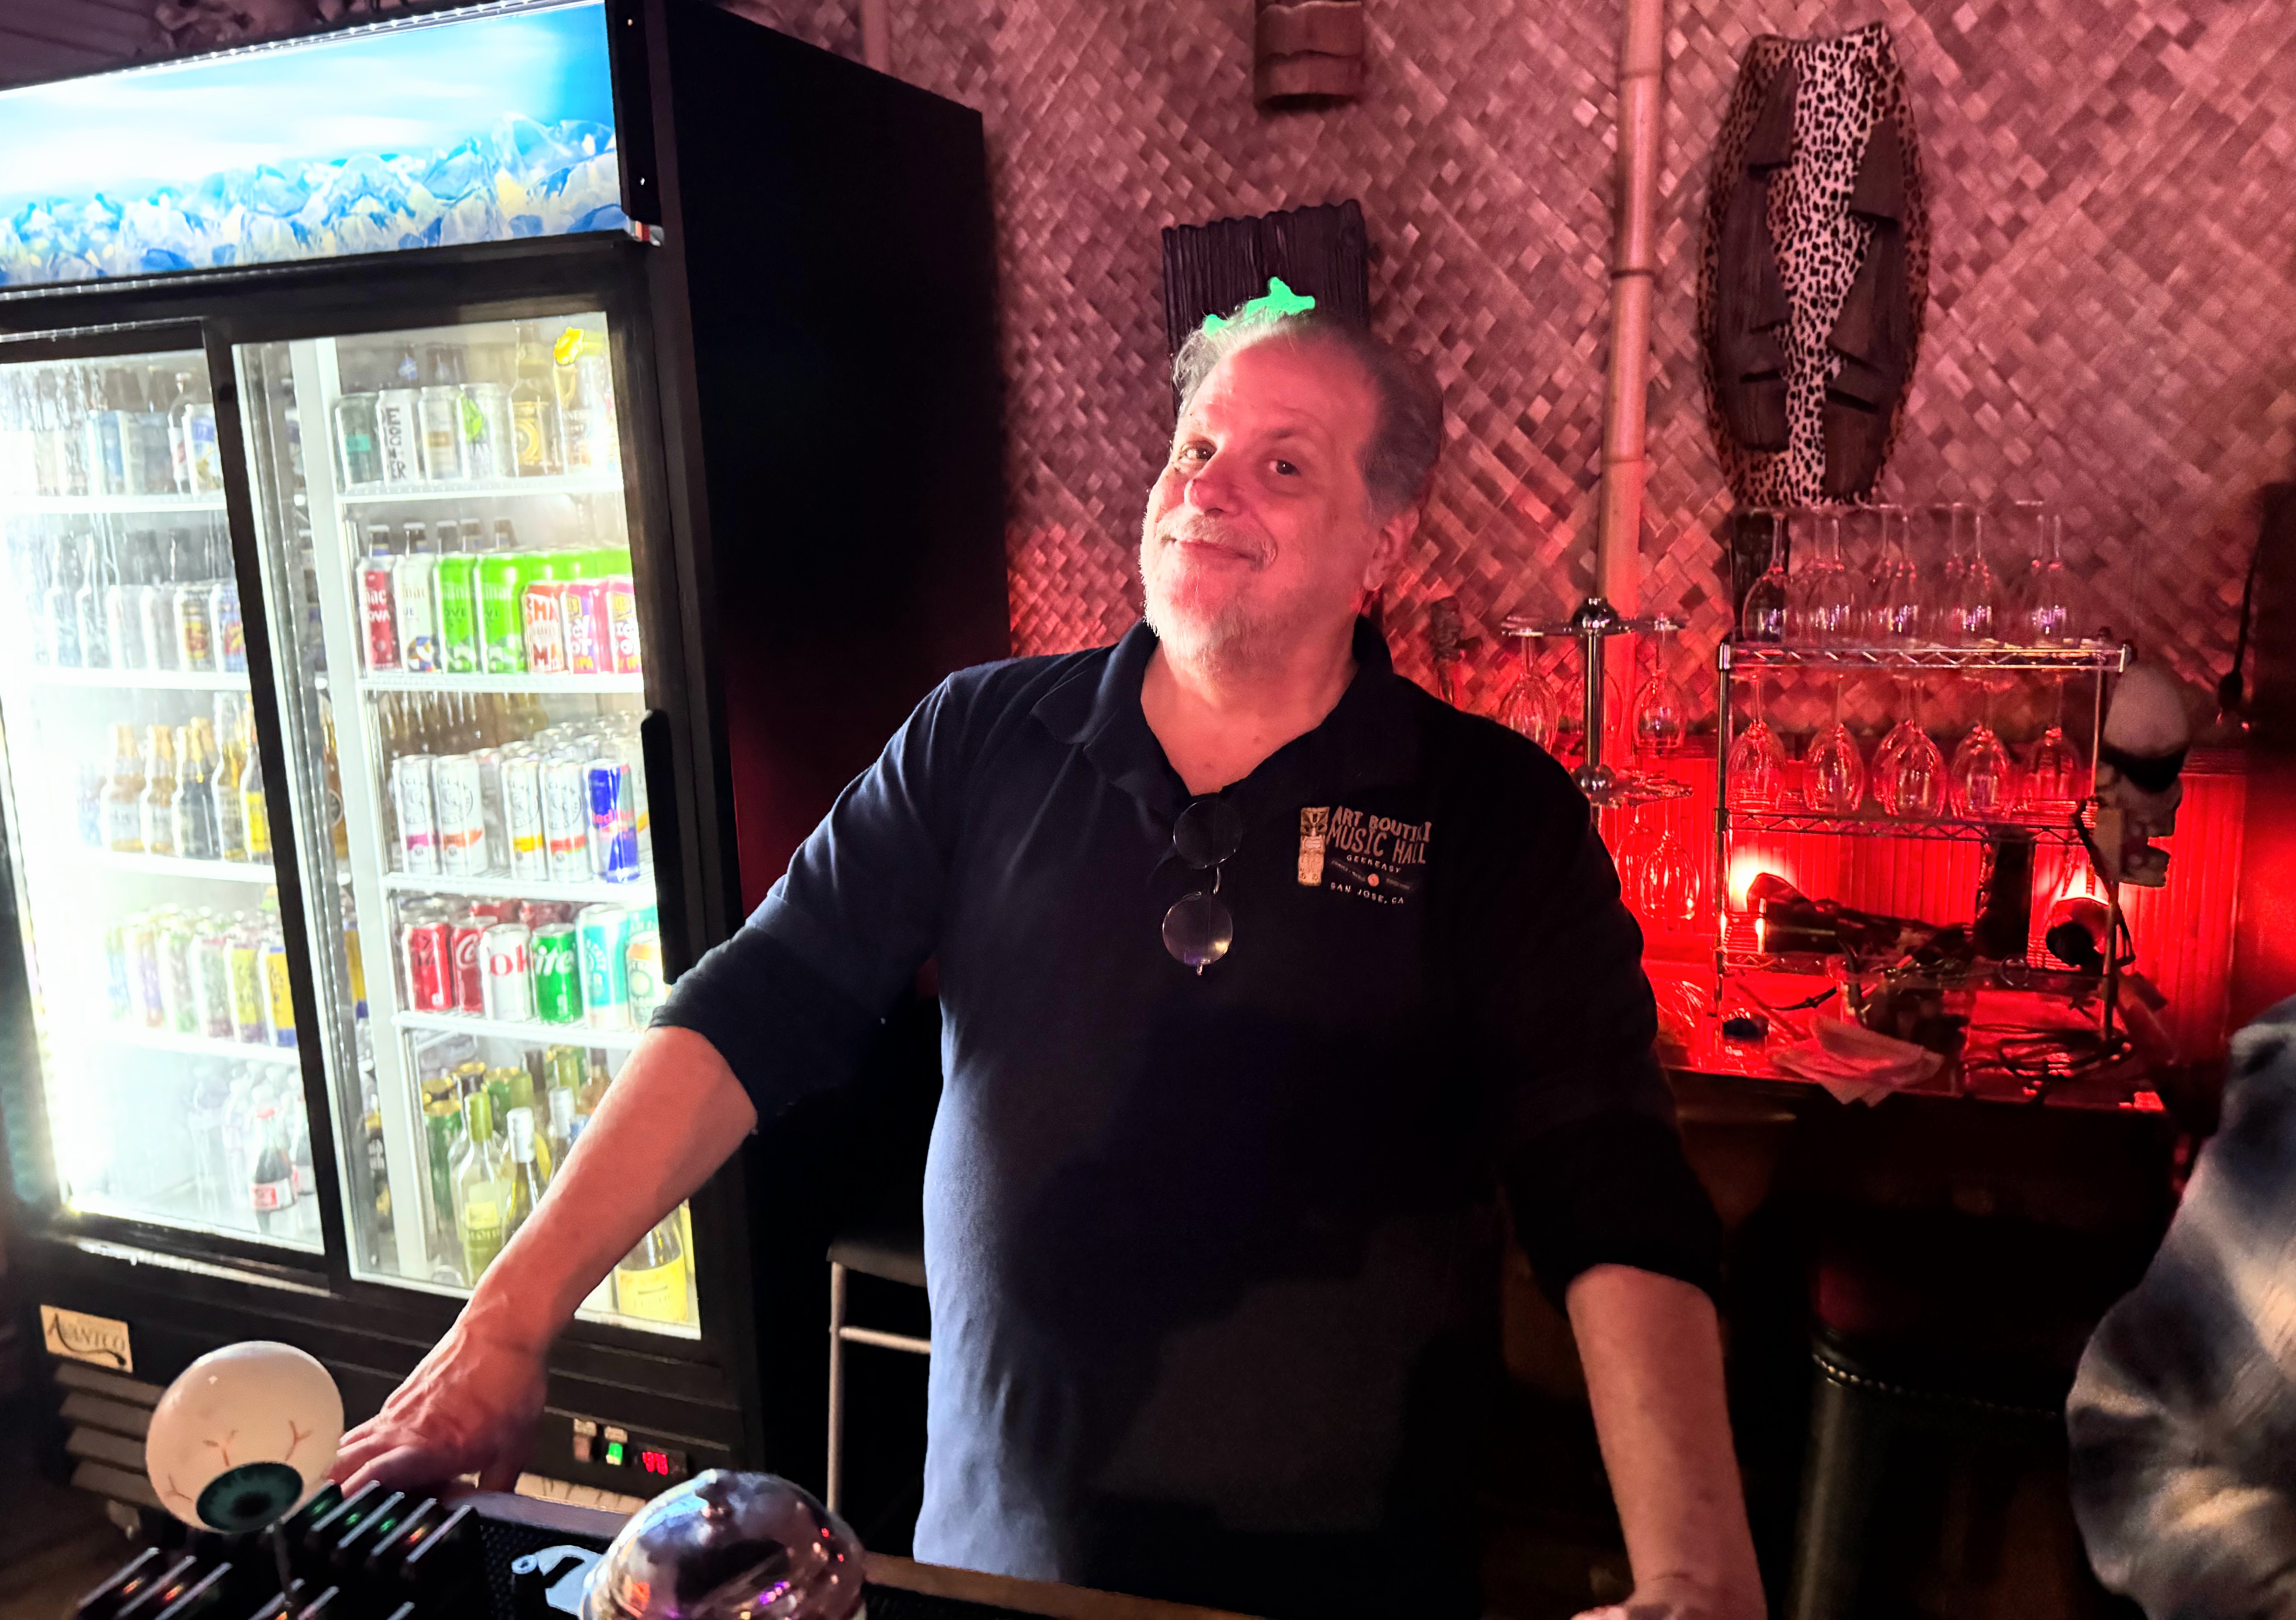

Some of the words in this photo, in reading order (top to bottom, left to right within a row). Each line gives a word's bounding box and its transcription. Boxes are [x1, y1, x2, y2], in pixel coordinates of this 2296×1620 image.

[1326, 822, 1388, 857] MUSIC
[1392, 838, 1426, 864] HALL
[1331, 805, 1364, 827] ART
[1368, 815, 1433, 843] BOUTIKI
[1330, 882, 1351, 893] SAN
